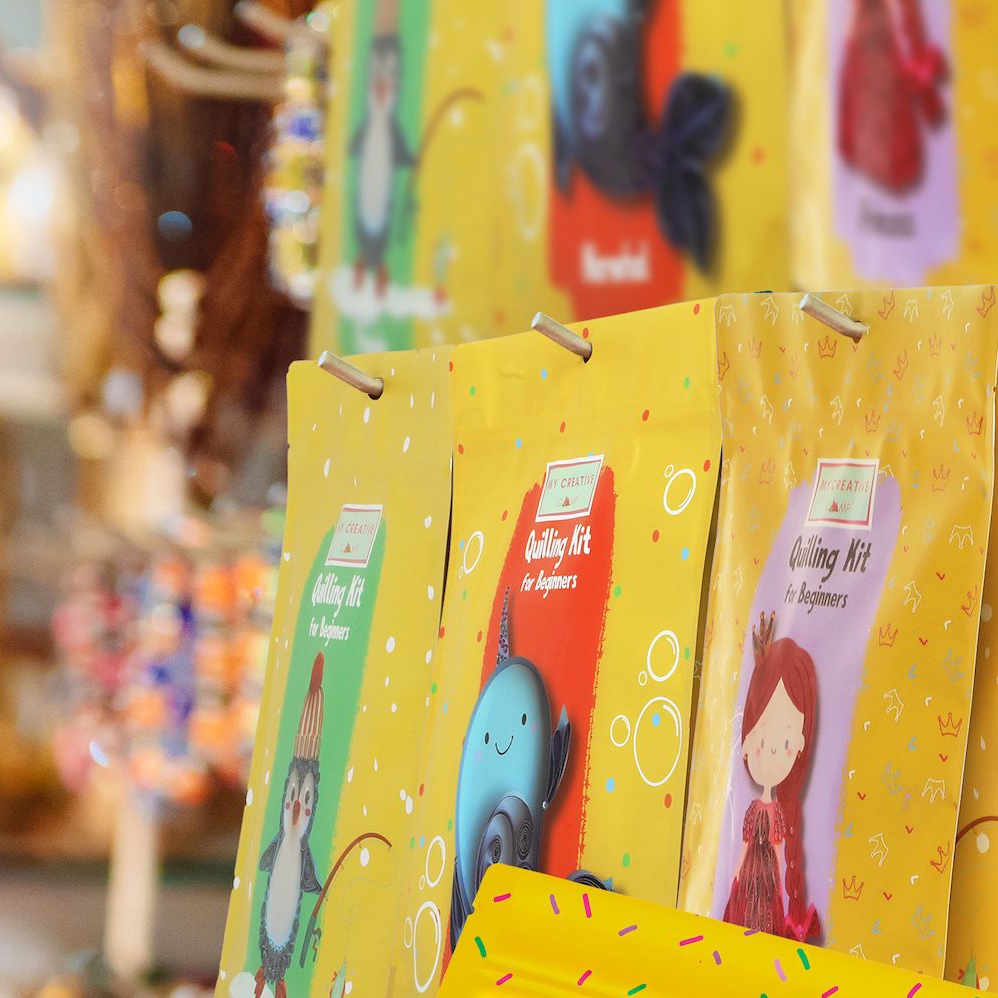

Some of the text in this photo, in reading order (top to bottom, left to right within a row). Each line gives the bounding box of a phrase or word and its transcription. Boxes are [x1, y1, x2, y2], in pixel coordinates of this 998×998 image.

[832, 479, 870, 493] CREATIVE
[525, 524, 591, 570] Quilling Kit
[789, 534, 872, 582] Quilling Kit
[311, 572, 366, 618] Quilling Kit
[520, 570, 578, 599] for Beginners
[784, 581, 849, 614] for Beginners
[308, 616, 350, 647] for Beginners
